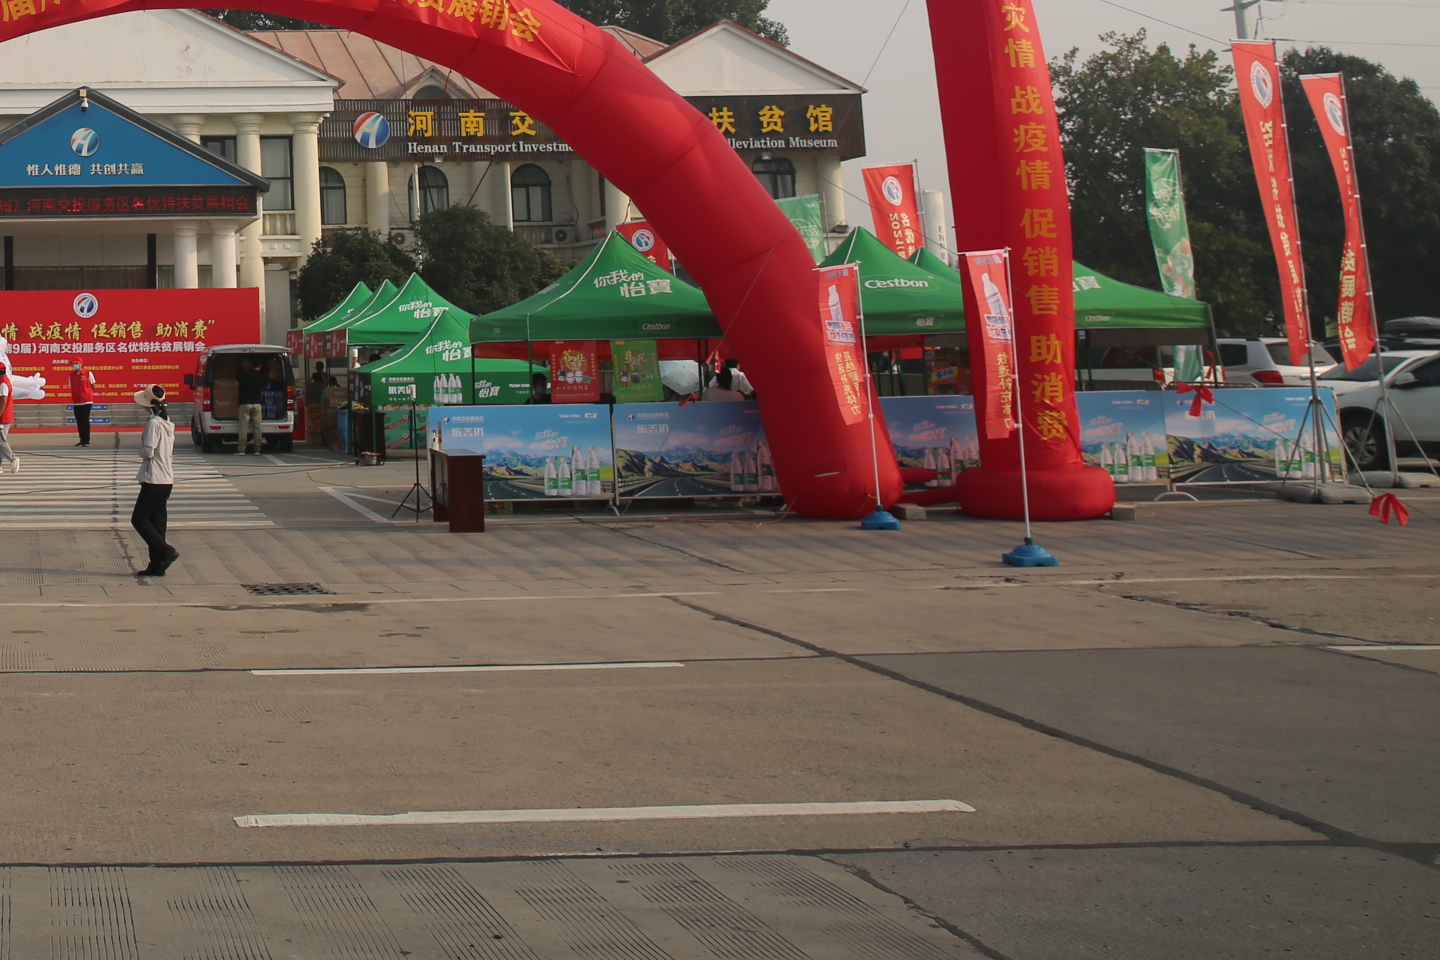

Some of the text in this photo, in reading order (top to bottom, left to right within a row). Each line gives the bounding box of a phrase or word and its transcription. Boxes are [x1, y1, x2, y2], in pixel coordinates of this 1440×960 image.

[407, 110, 536, 137] 河南交
[709, 104, 834, 134] 扶贫馆
[408, 142, 448, 153] Henan
[452, 141, 517, 155] Transport
[725, 136, 839, 150] lleviation Museum
[1011, 86, 1052, 190] 战疫情
[26, 162, 145, 176] 惟人惟德 共创共赢
[1020, 208, 1061, 316] 促销售
[593, 268, 645, 288] 你我的
[28, 321, 82, 341] 战疫情
[91, 320, 144, 340] 促销售
[1028, 334, 1069, 440] 助消费
